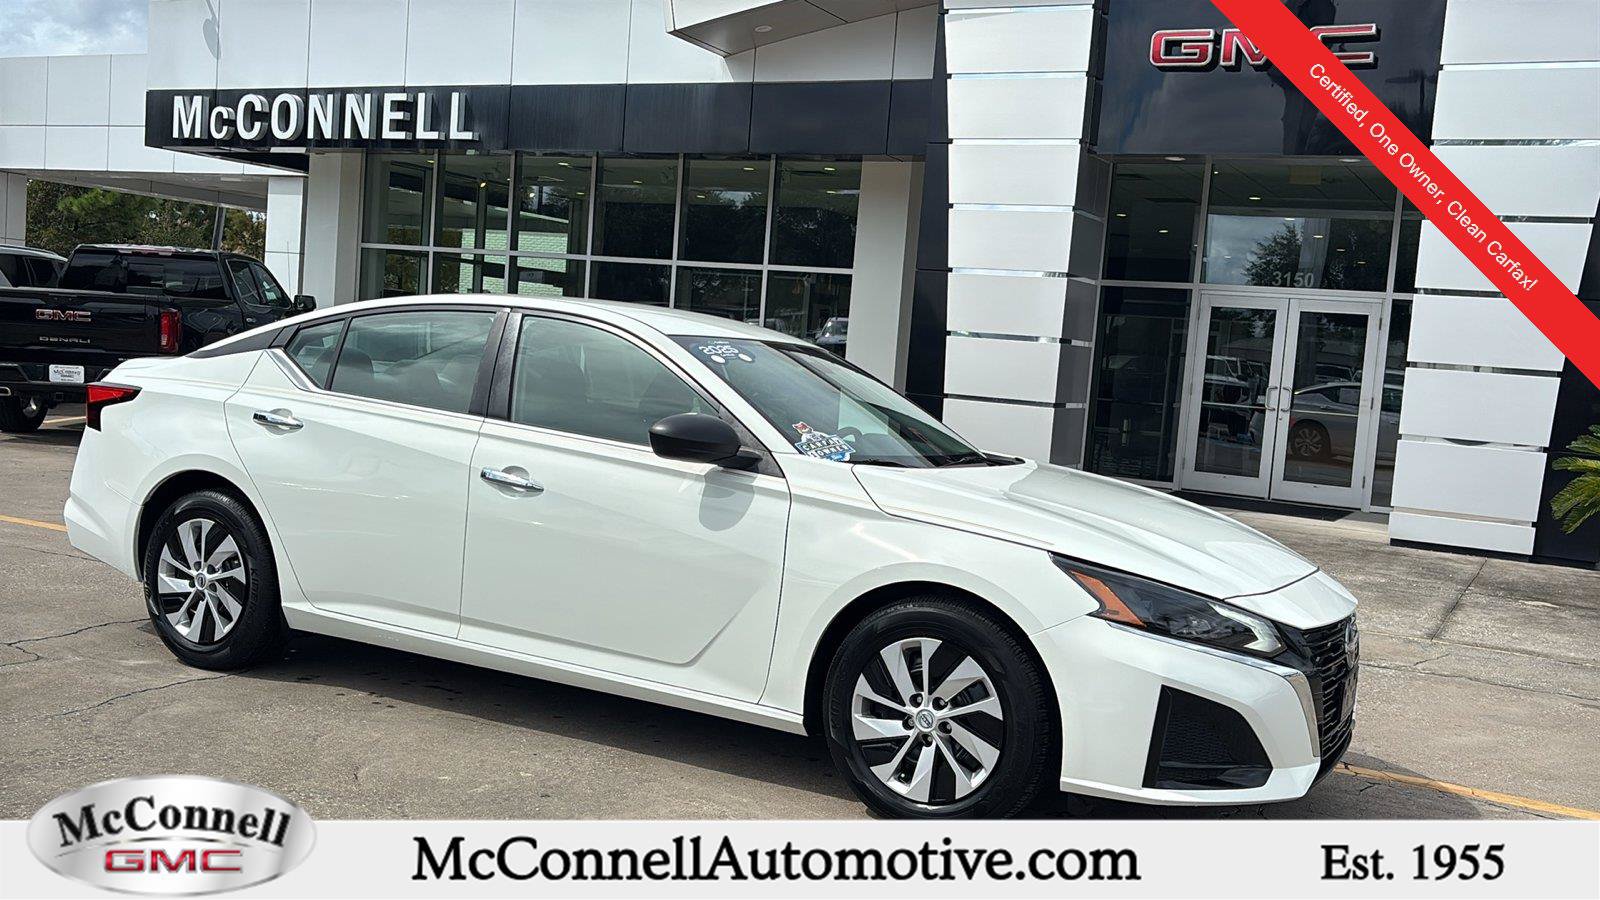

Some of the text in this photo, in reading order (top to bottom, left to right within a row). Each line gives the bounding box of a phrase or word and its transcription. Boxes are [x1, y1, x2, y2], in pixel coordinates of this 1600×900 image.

[172, 91, 478, 141] McCONNELL
[1272, 271, 1314, 288] 3150
[35, 308, 91, 322] GMC
[39, 336, 91, 344] DENALI
